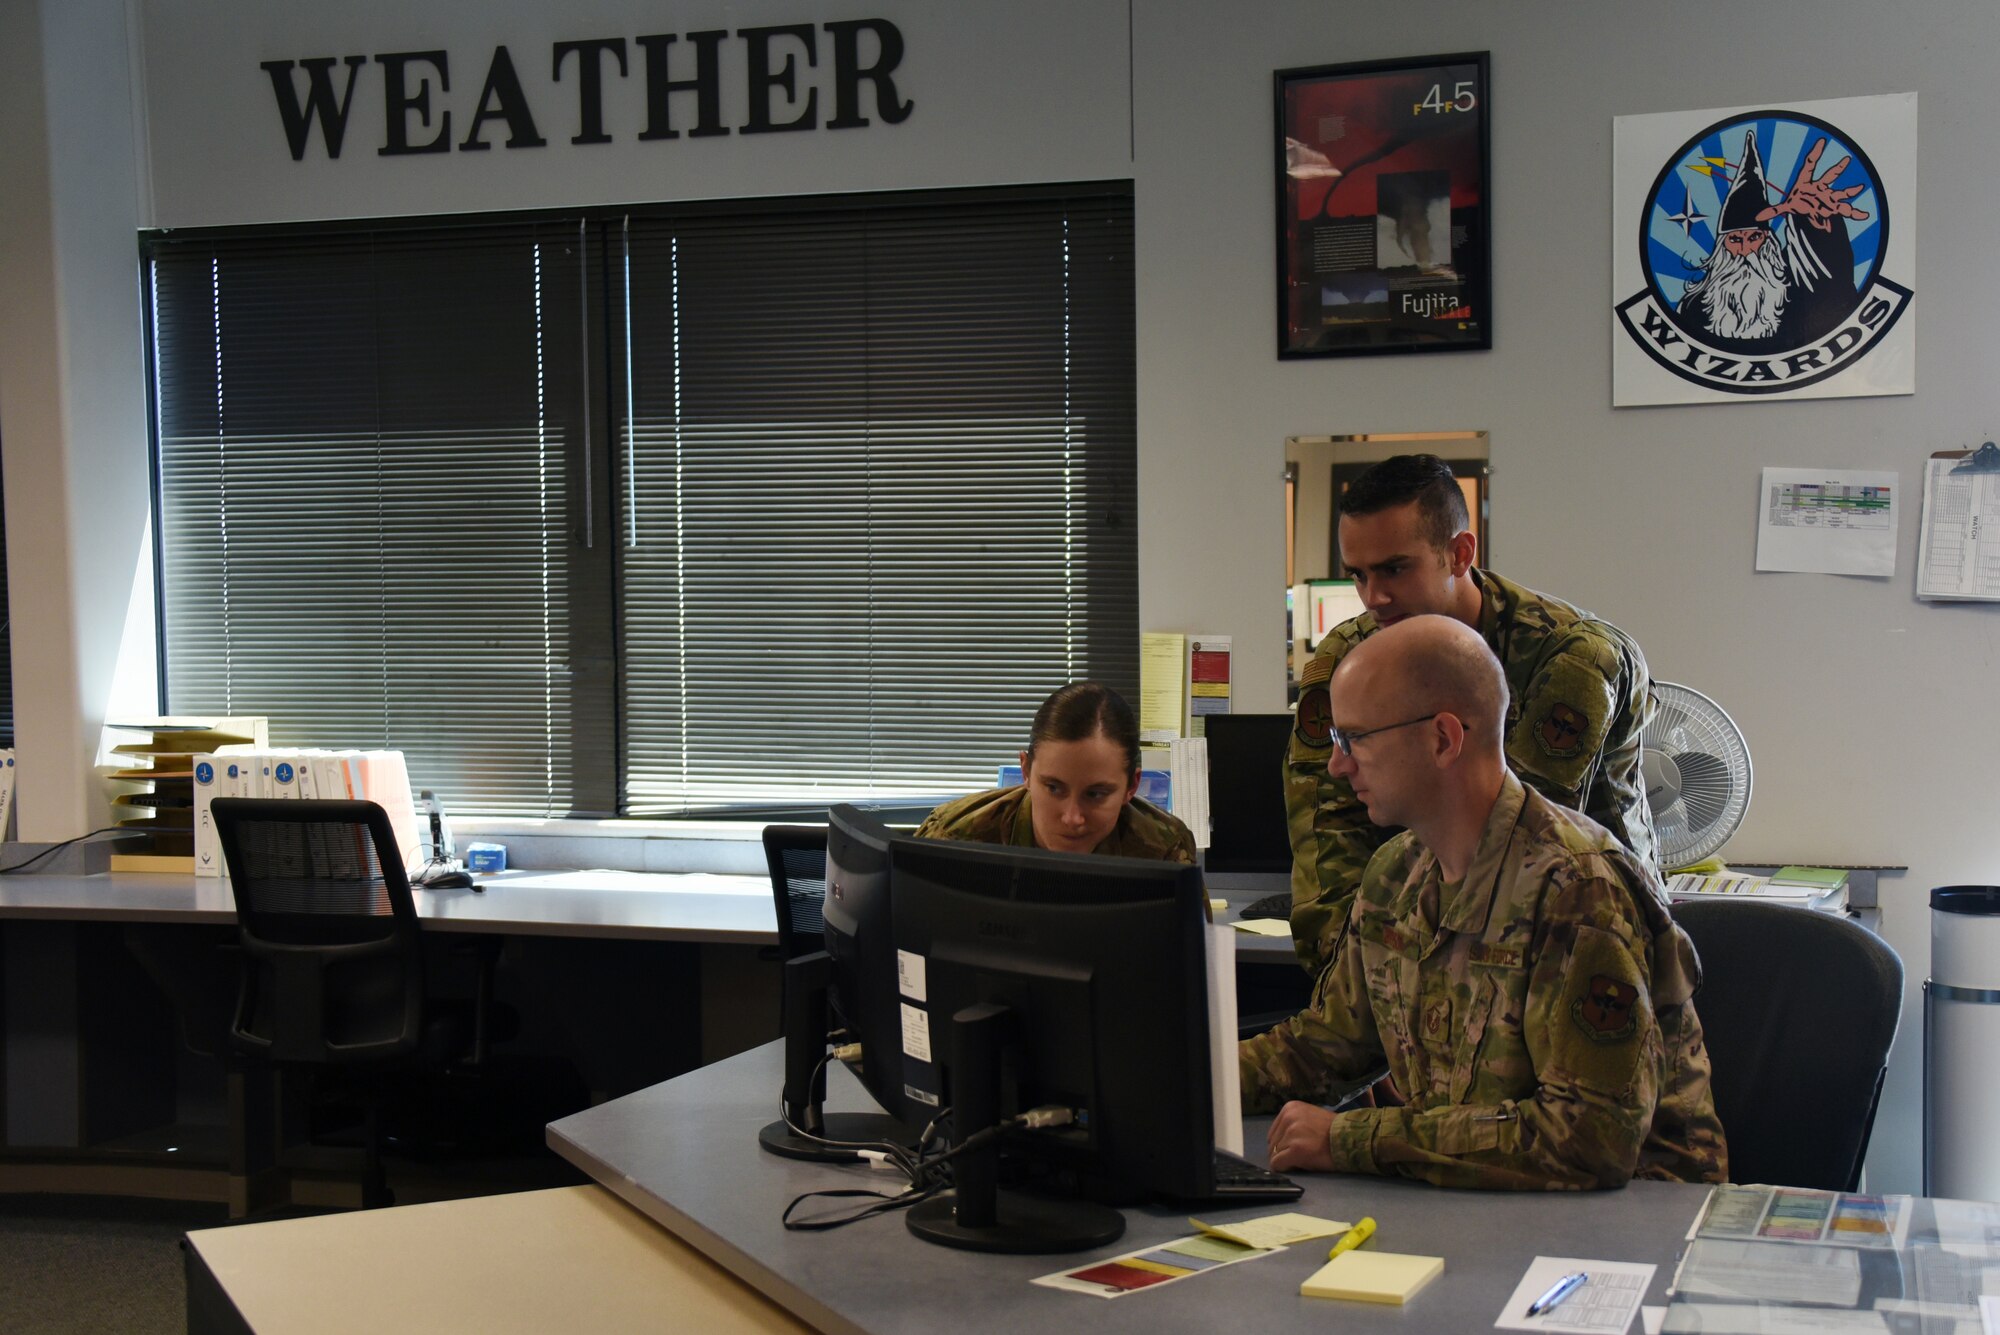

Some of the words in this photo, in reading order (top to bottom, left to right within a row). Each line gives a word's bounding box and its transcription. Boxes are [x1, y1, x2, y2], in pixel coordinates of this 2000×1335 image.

[260, 18, 914, 161] WEATHER
[1402, 293, 1459, 318] Fujita
[1639, 296, 1891, 382] WIZARDS
